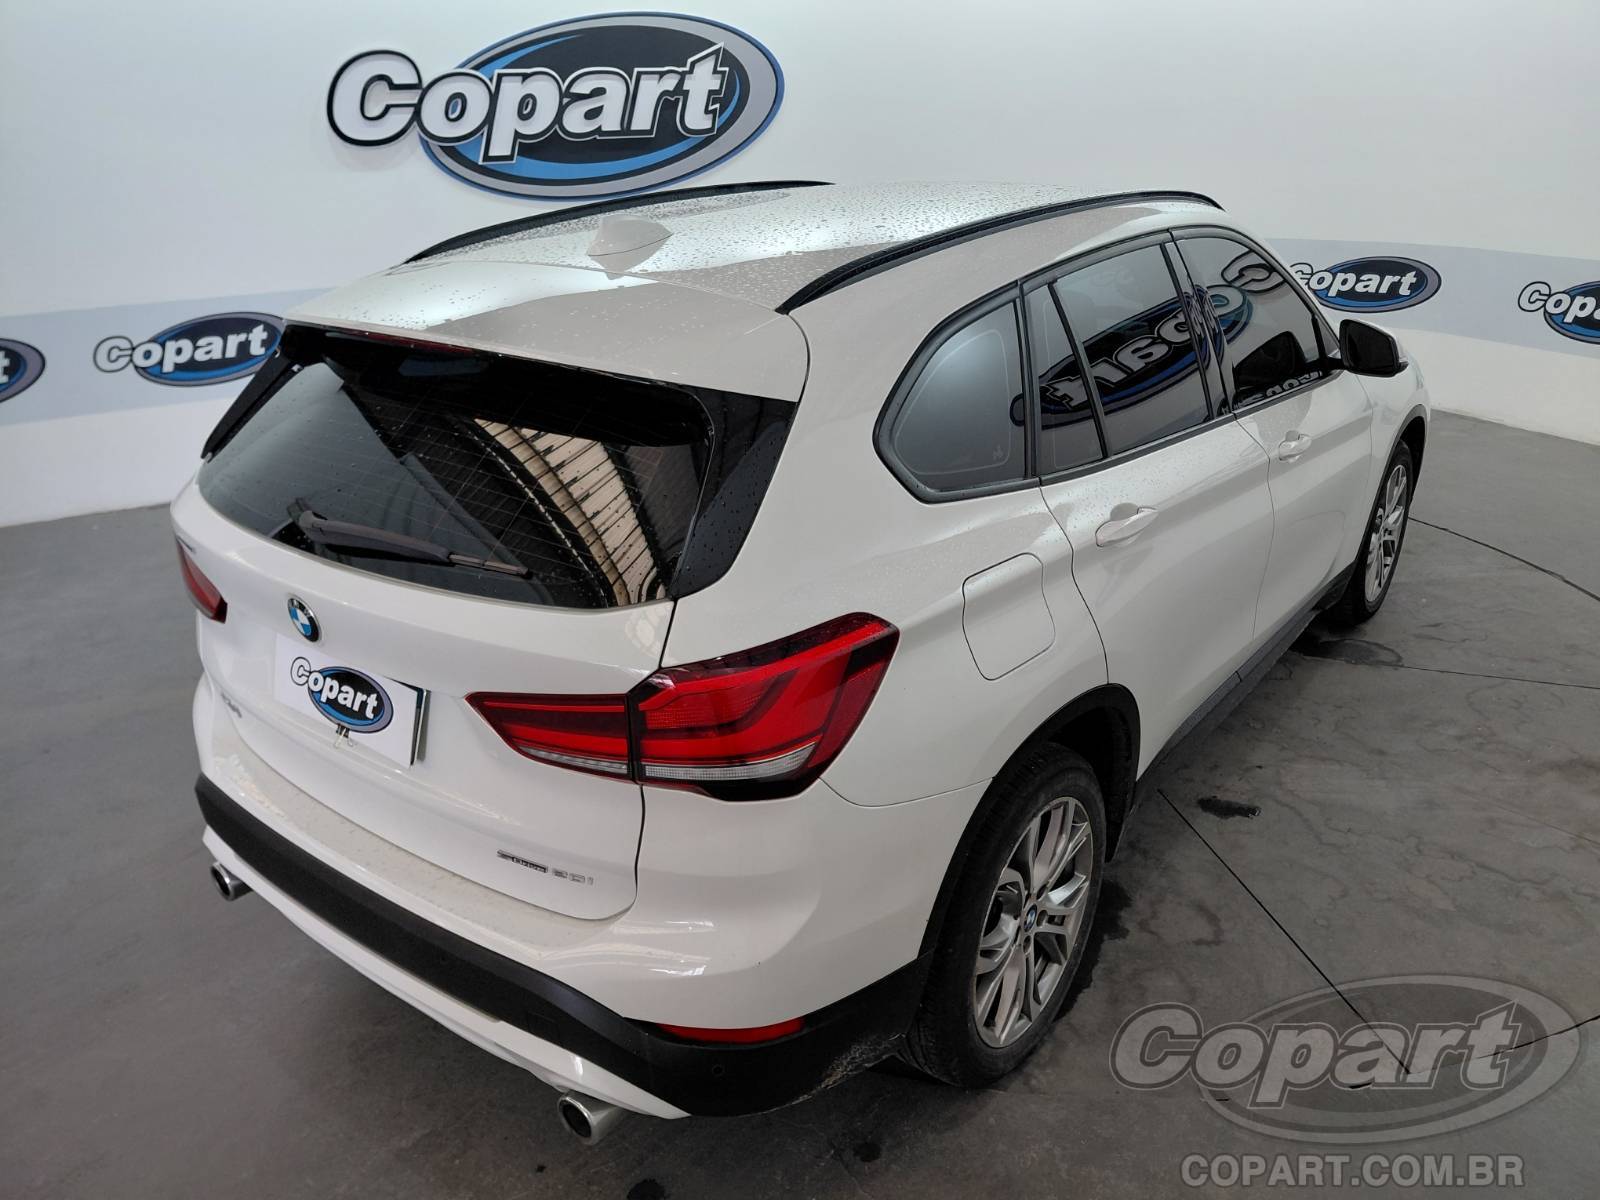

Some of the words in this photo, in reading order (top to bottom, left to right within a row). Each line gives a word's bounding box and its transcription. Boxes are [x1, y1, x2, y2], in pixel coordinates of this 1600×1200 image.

[327, 42, 729, 164] Copart
[1518, 281, 1600, 323] Cop
[94, 324, 268, 373] Copart
[290, 656, 378, 719] Copart
